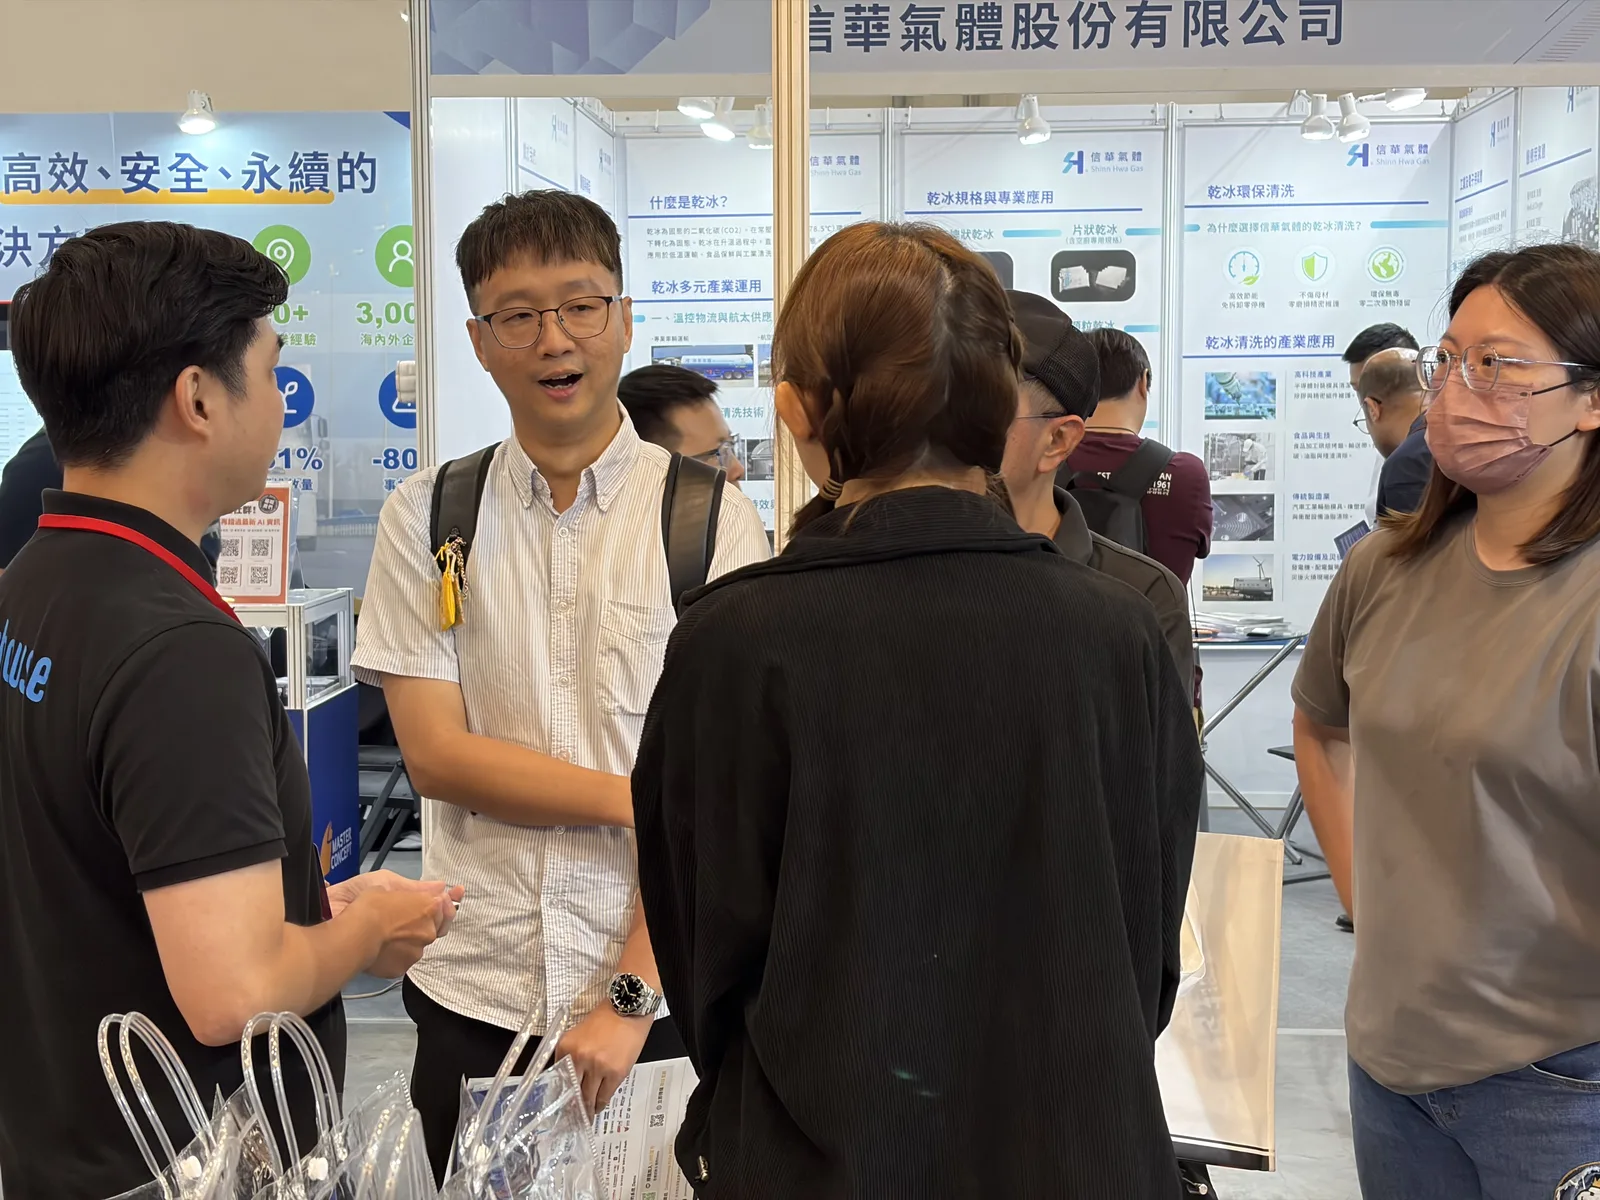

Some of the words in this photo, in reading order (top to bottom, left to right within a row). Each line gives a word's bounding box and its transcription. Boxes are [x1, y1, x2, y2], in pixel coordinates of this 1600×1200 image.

[1091, 151, 1142, 163] 信華氣體
[1376, 144, 1429, 156] 信華氣體
[2, 151, 377, 195] 高效、安全、永續的
[927, 190, 1054, 206] 乾冰規格與專業應用
[1207, 184, 1295, 199] 乾冰環保清洗
[1073, 224, 1118, 236] 片狀乾冰
[0, 225, 91, 268] 決方
[652, 279, 762, 294] 乾冰多元產業運用
[1205, 334, 1335, 350] 乾冰清洗的產業應用
[269, 447, 323, 470] 1%
[332, 827, 352, 854] MASTER
[330, 841, 352, 870] CONCEPT
